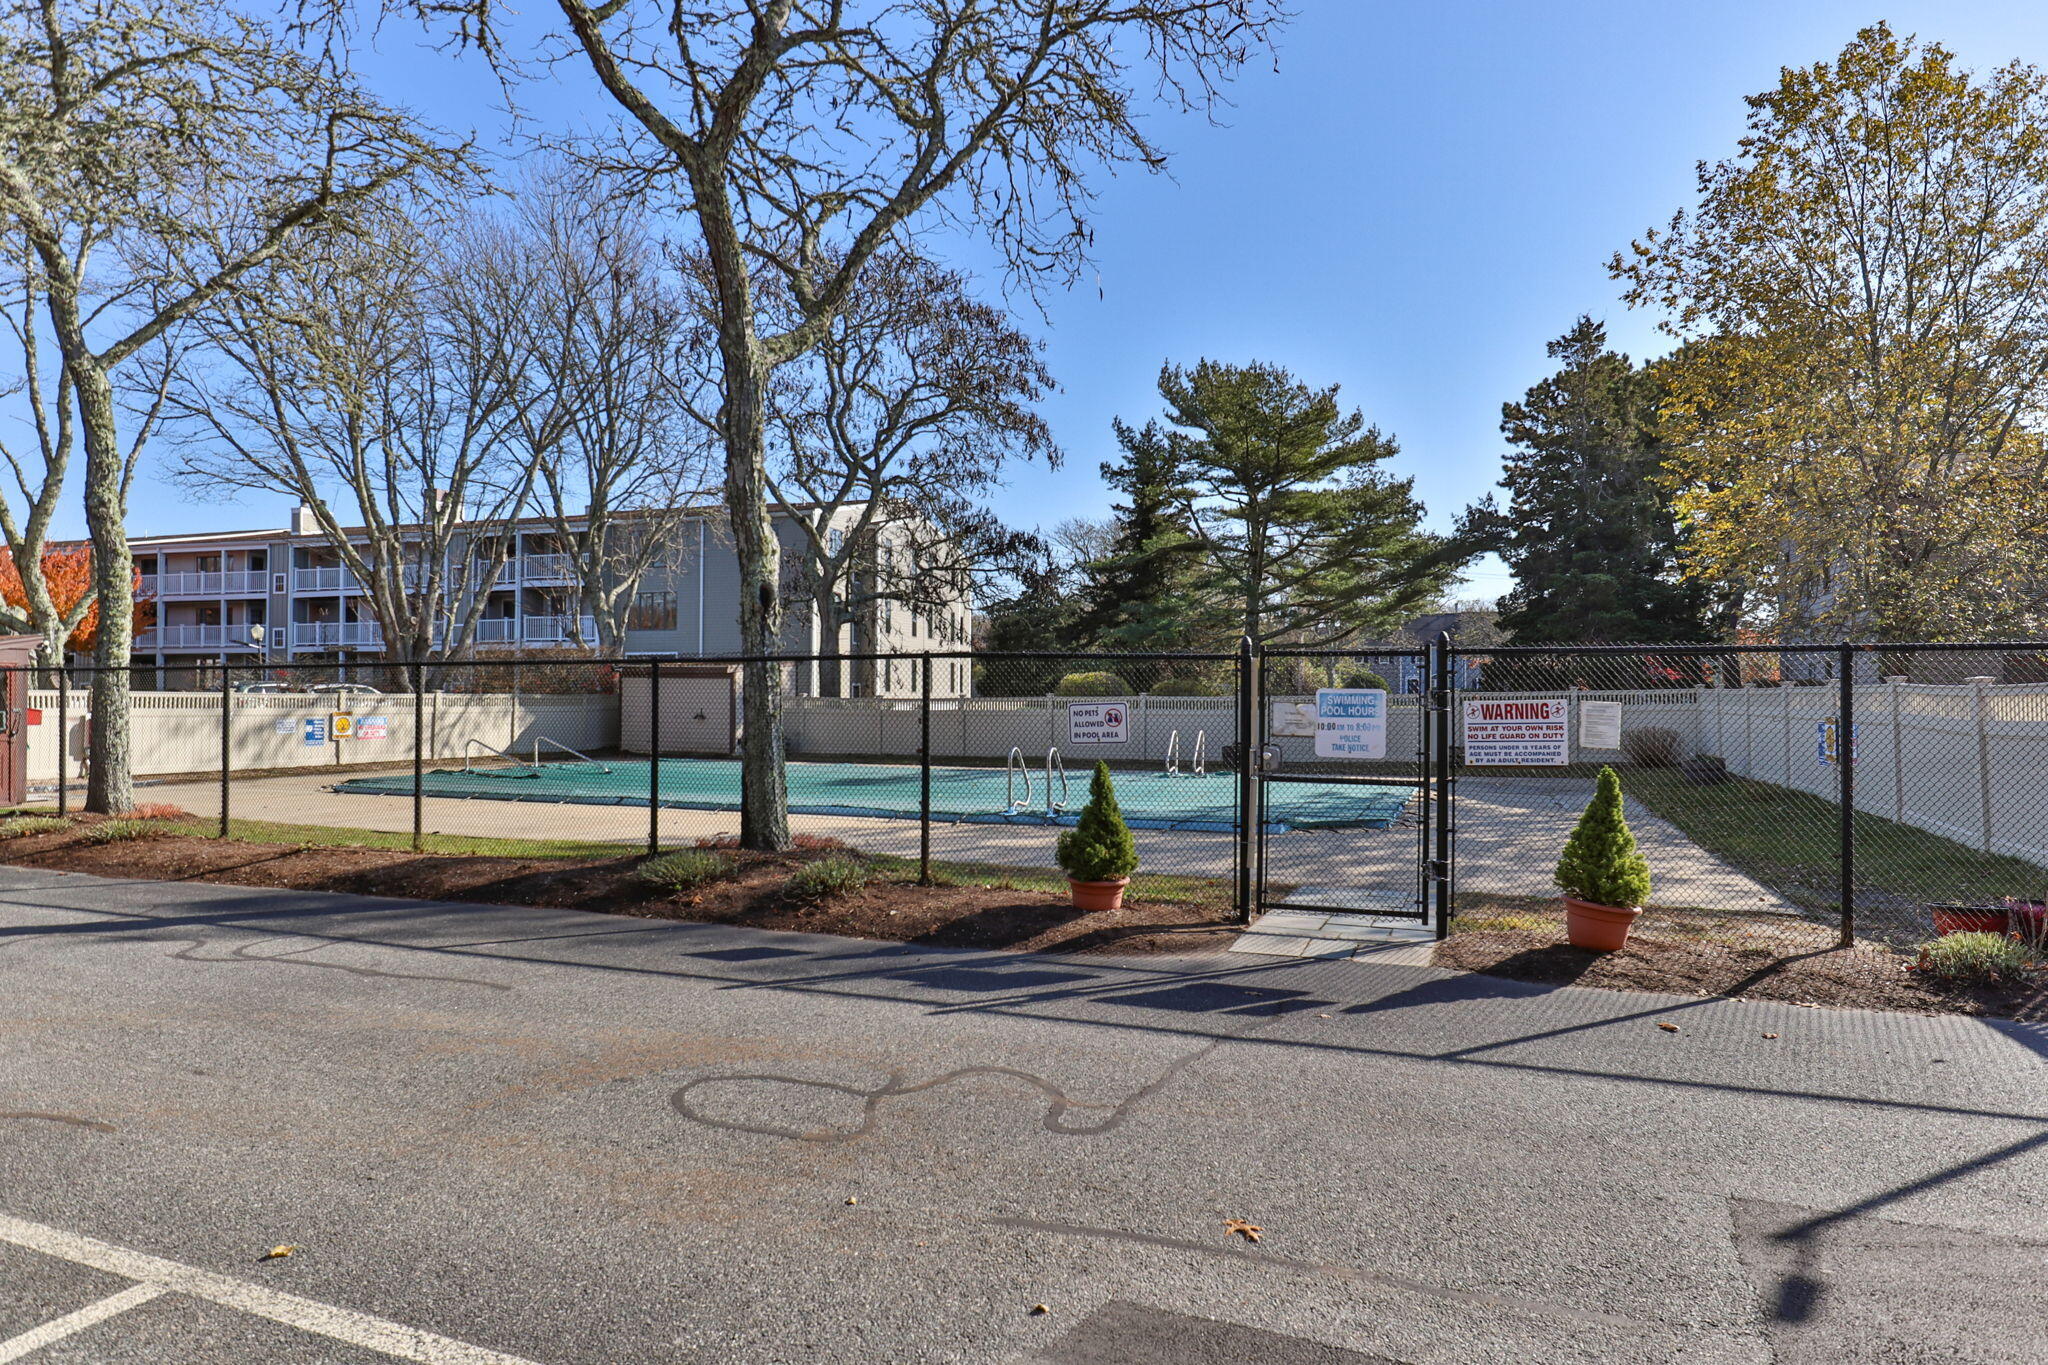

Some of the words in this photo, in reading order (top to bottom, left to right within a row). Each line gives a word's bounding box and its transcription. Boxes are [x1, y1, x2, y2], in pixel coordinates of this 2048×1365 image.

[1328, 696, 1374, 704] SWIMMING
[1321, 706, 1345, 715] POOL
[1481, 703, 1549, 720] WARNING
